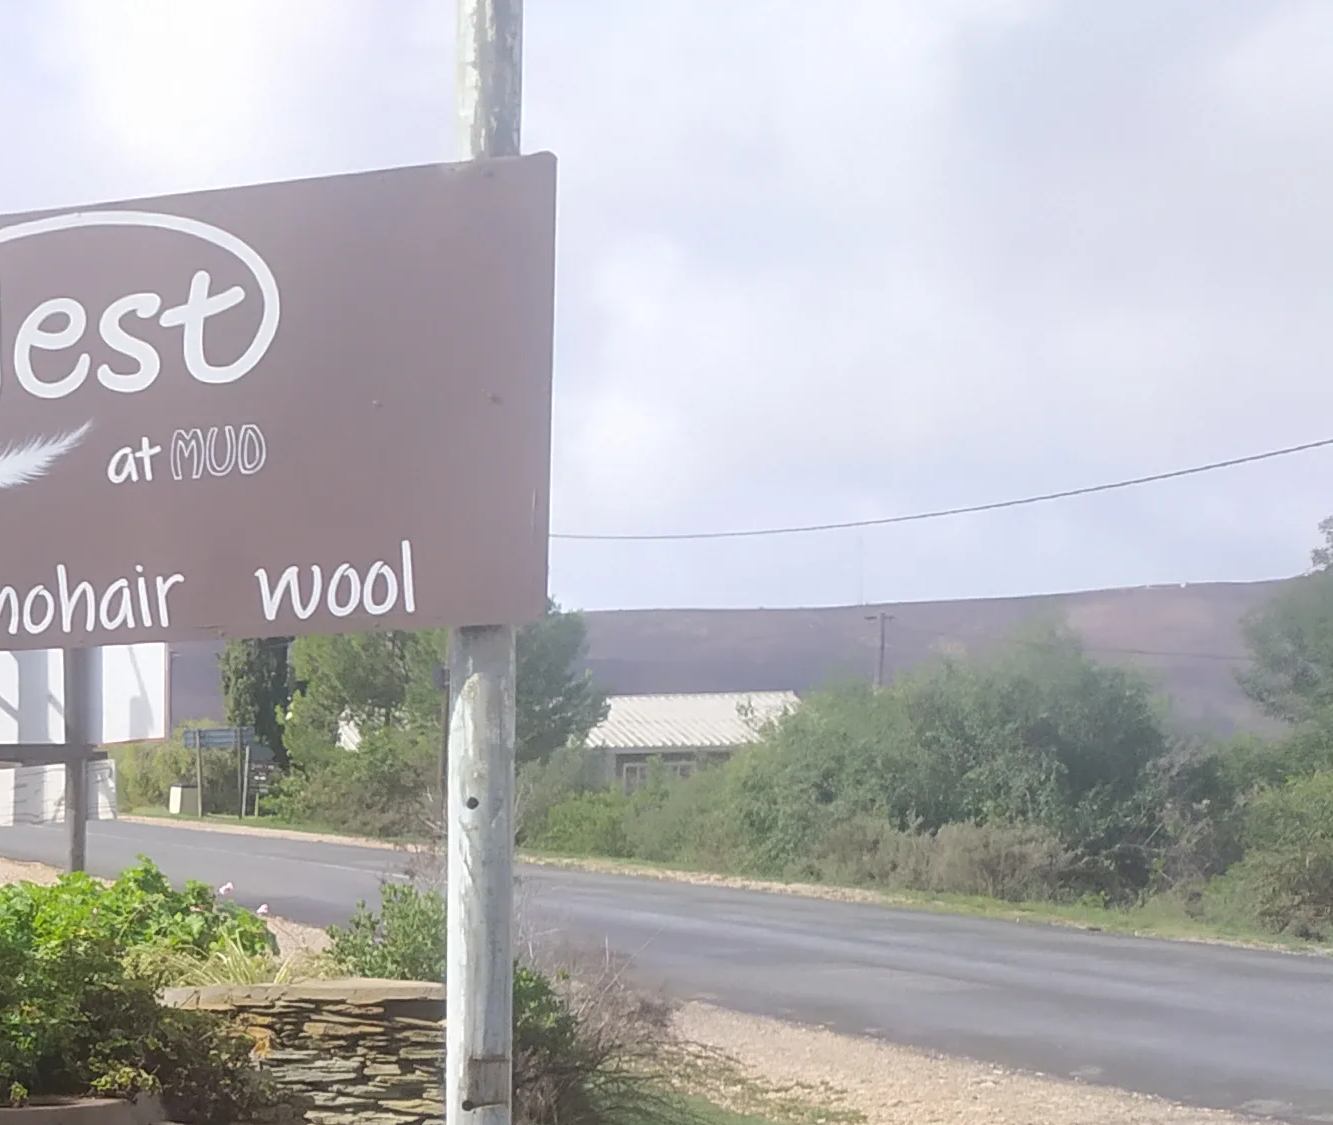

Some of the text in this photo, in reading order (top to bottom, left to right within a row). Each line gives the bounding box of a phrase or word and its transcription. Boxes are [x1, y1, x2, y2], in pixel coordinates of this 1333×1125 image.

[107, 424, 267, 484] at MUD
[255, 539, 417, 621] wool
